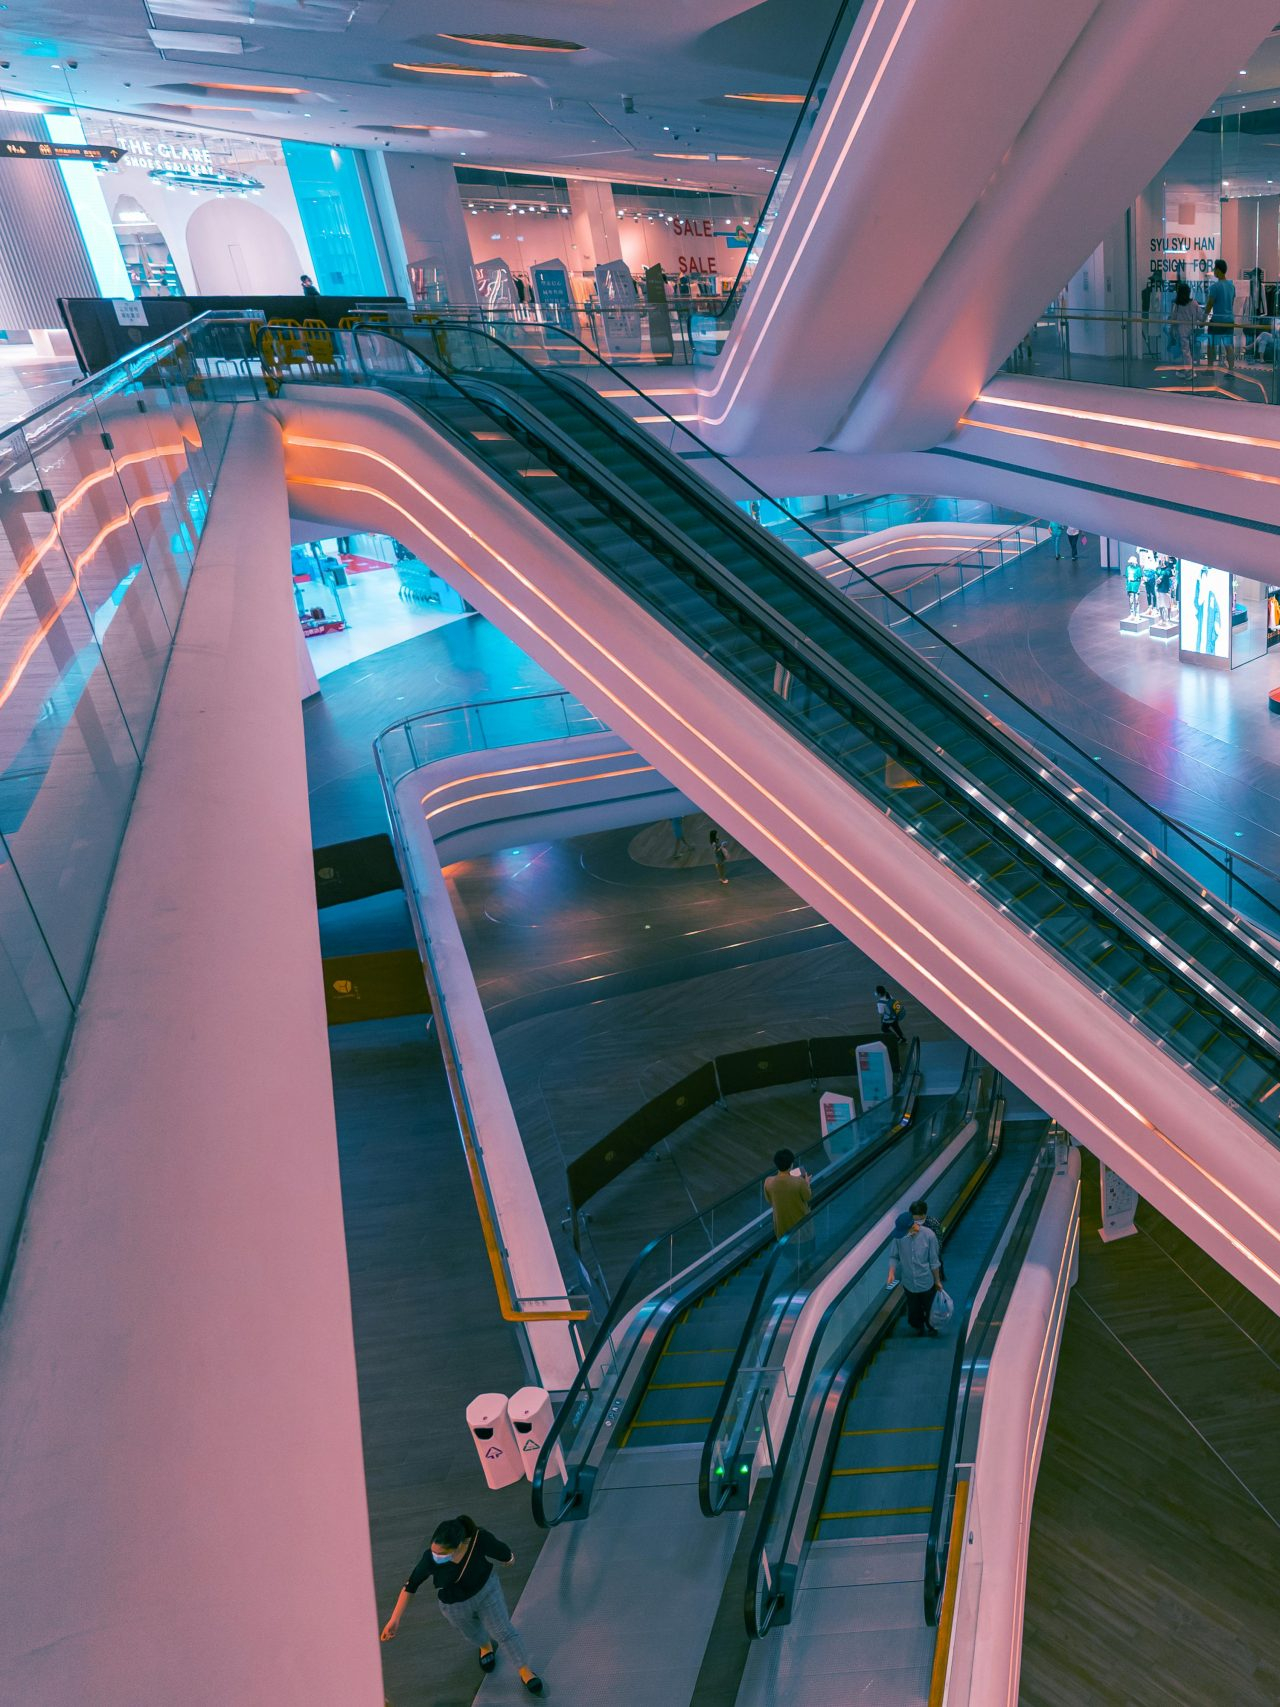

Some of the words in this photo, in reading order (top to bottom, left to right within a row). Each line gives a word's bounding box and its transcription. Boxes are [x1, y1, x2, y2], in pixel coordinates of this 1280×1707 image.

[117, 138, 154, 157] THE
[157, 143, 213, 165] GLARE
[673, 218, 713, 238] SALE
[1150, 238, 1169, 252] SYU
[1172, 237, 1191, 251] SYU
[1194, 236, 1215, 250] HAN
[678, 255, 718, 274] SALE
[1150, 258, 1185, 273] DESIGN
